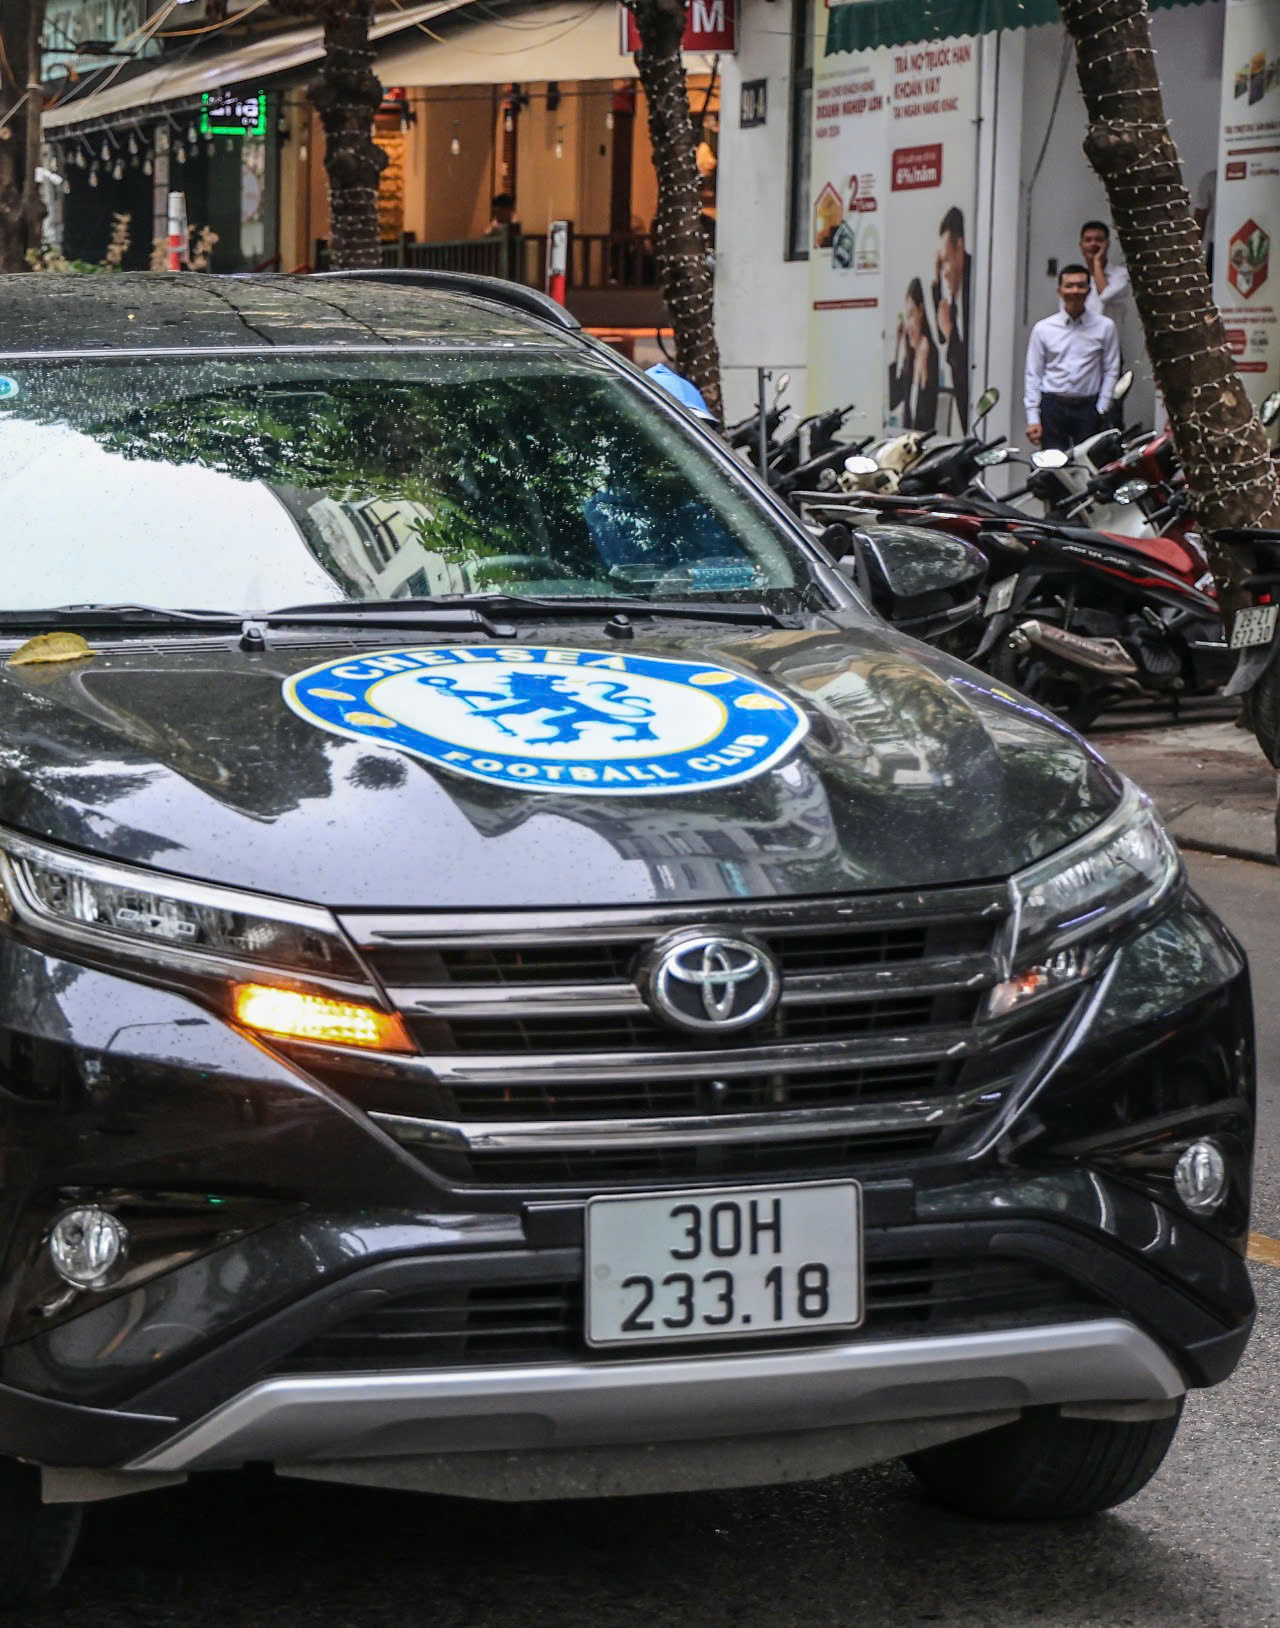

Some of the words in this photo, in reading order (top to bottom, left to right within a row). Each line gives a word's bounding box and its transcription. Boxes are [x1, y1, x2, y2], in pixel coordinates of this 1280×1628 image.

[331, 648, 627, 680] CHELSEA
[441, 750, 681, 782] FOOTBALL
[687, 733, 769, 772] CLUB
[669, 1198, 782, 1261] 30H
[621, 1262, 829, 1332] 233.18
